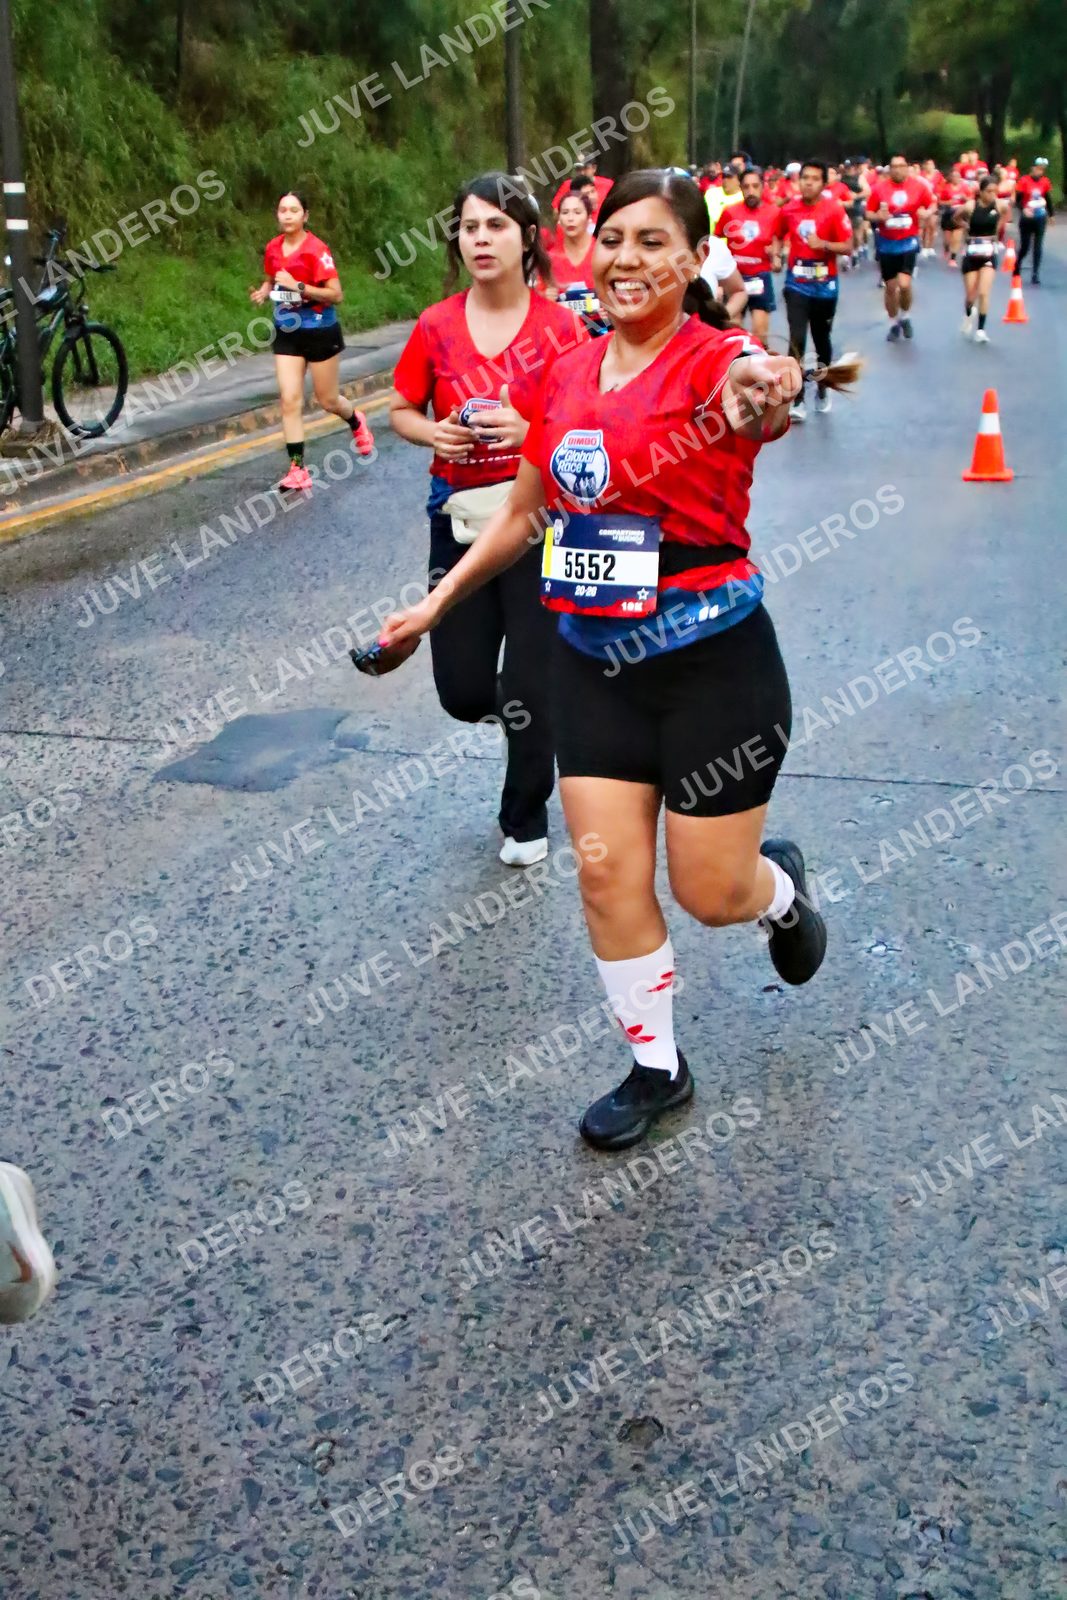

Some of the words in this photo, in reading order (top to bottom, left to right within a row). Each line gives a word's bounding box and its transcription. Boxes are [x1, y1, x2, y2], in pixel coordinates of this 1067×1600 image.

[565, 450, 595, 463] Global
[557, 461, 582, 473] Race
[564, 551, 616, 581] 5552
[621, 601, 643, 612] 10K
